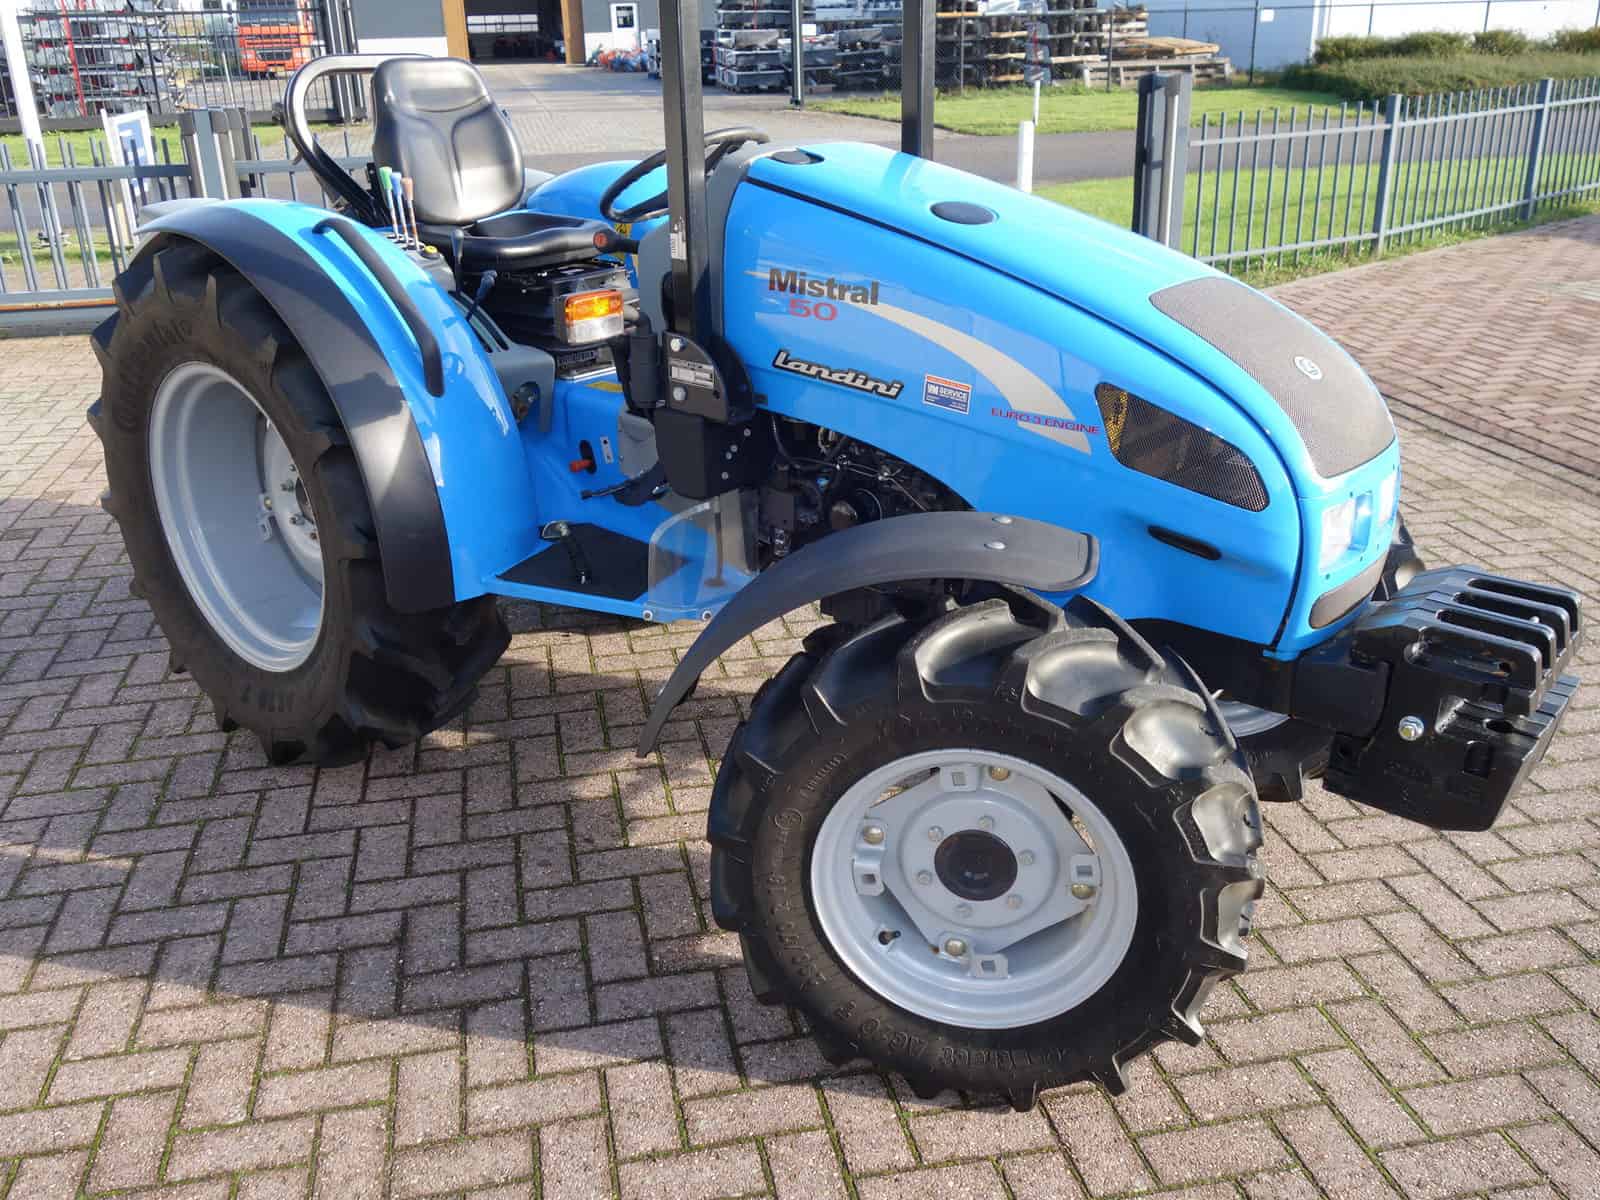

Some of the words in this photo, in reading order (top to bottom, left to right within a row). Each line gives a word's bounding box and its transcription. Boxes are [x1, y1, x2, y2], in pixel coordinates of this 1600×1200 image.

[768, 271, 880, 306] Mistral
[788, 298, 838, 321] 50
[772, 349, 904, 399] Landini
[991, 407, 1031, 423] EURO
[1044, 417, 1101, 434] ENGINE
